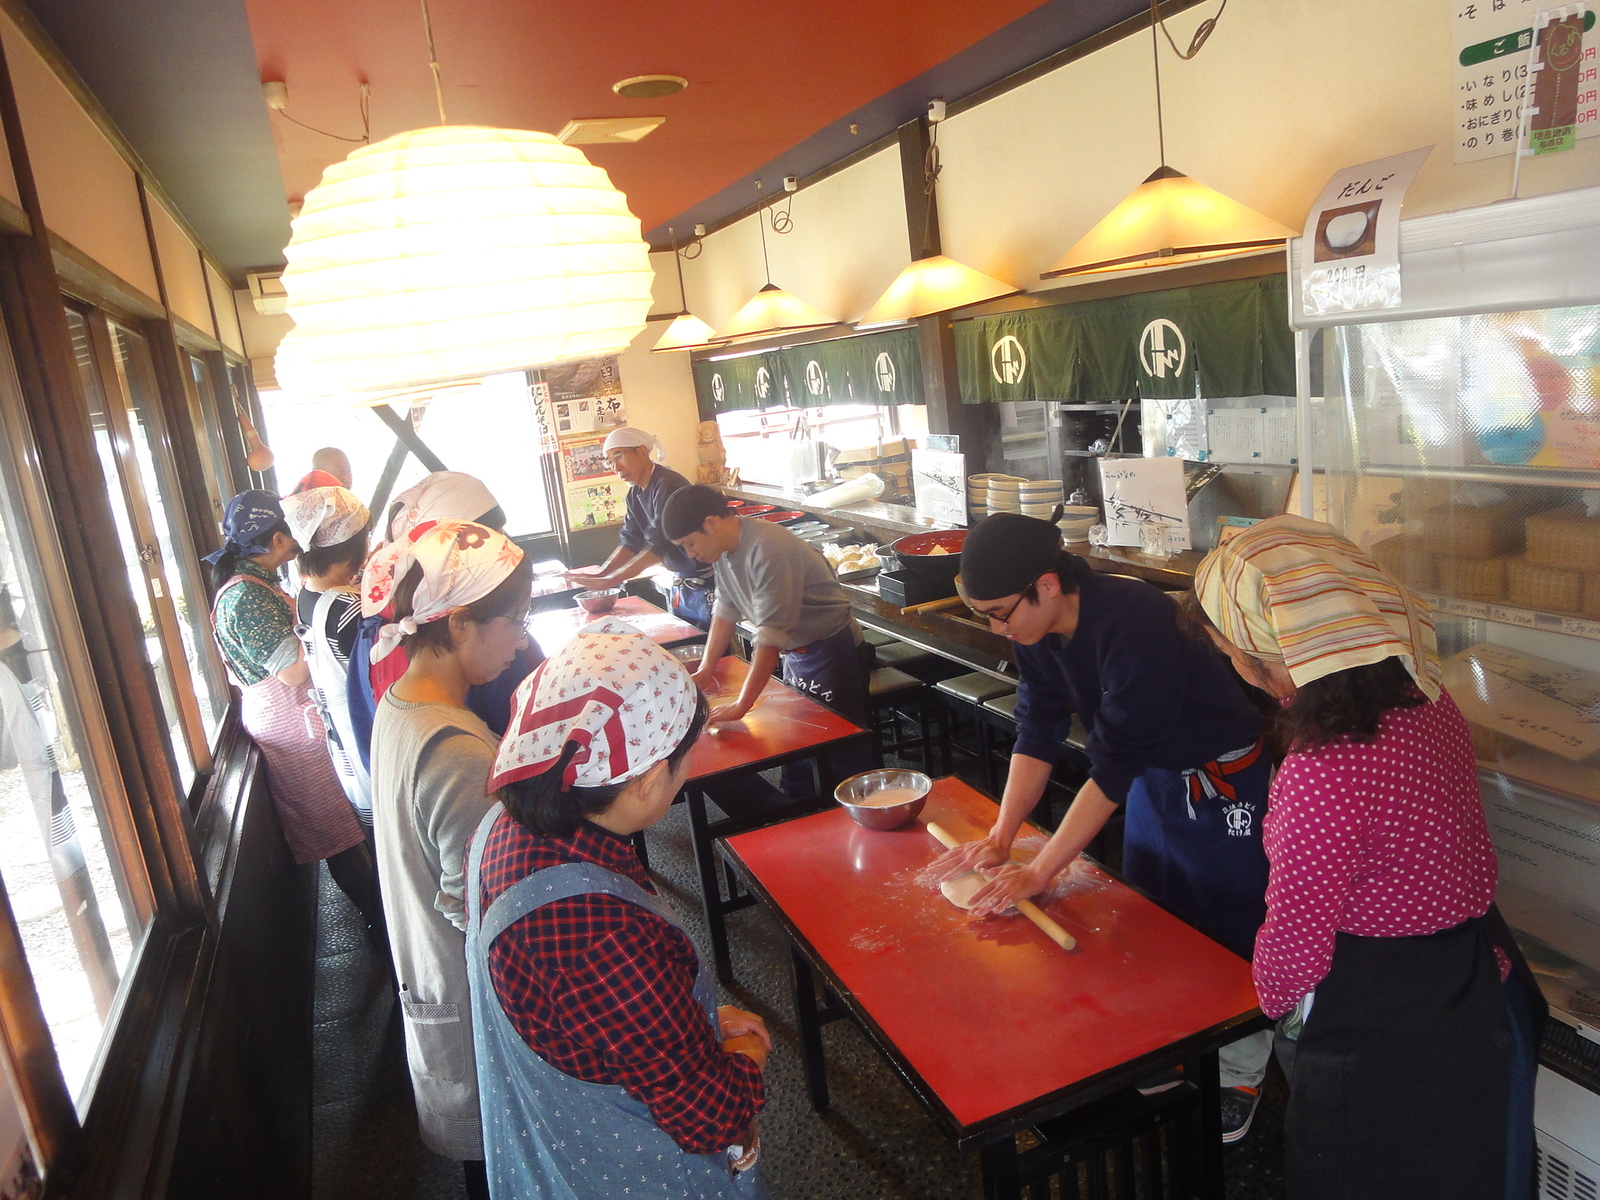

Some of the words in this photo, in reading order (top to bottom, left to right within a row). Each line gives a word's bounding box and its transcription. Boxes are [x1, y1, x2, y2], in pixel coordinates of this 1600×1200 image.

[1575, 109, 1597, 124] 0円
[1337, 173, 1395, 200] だんご
